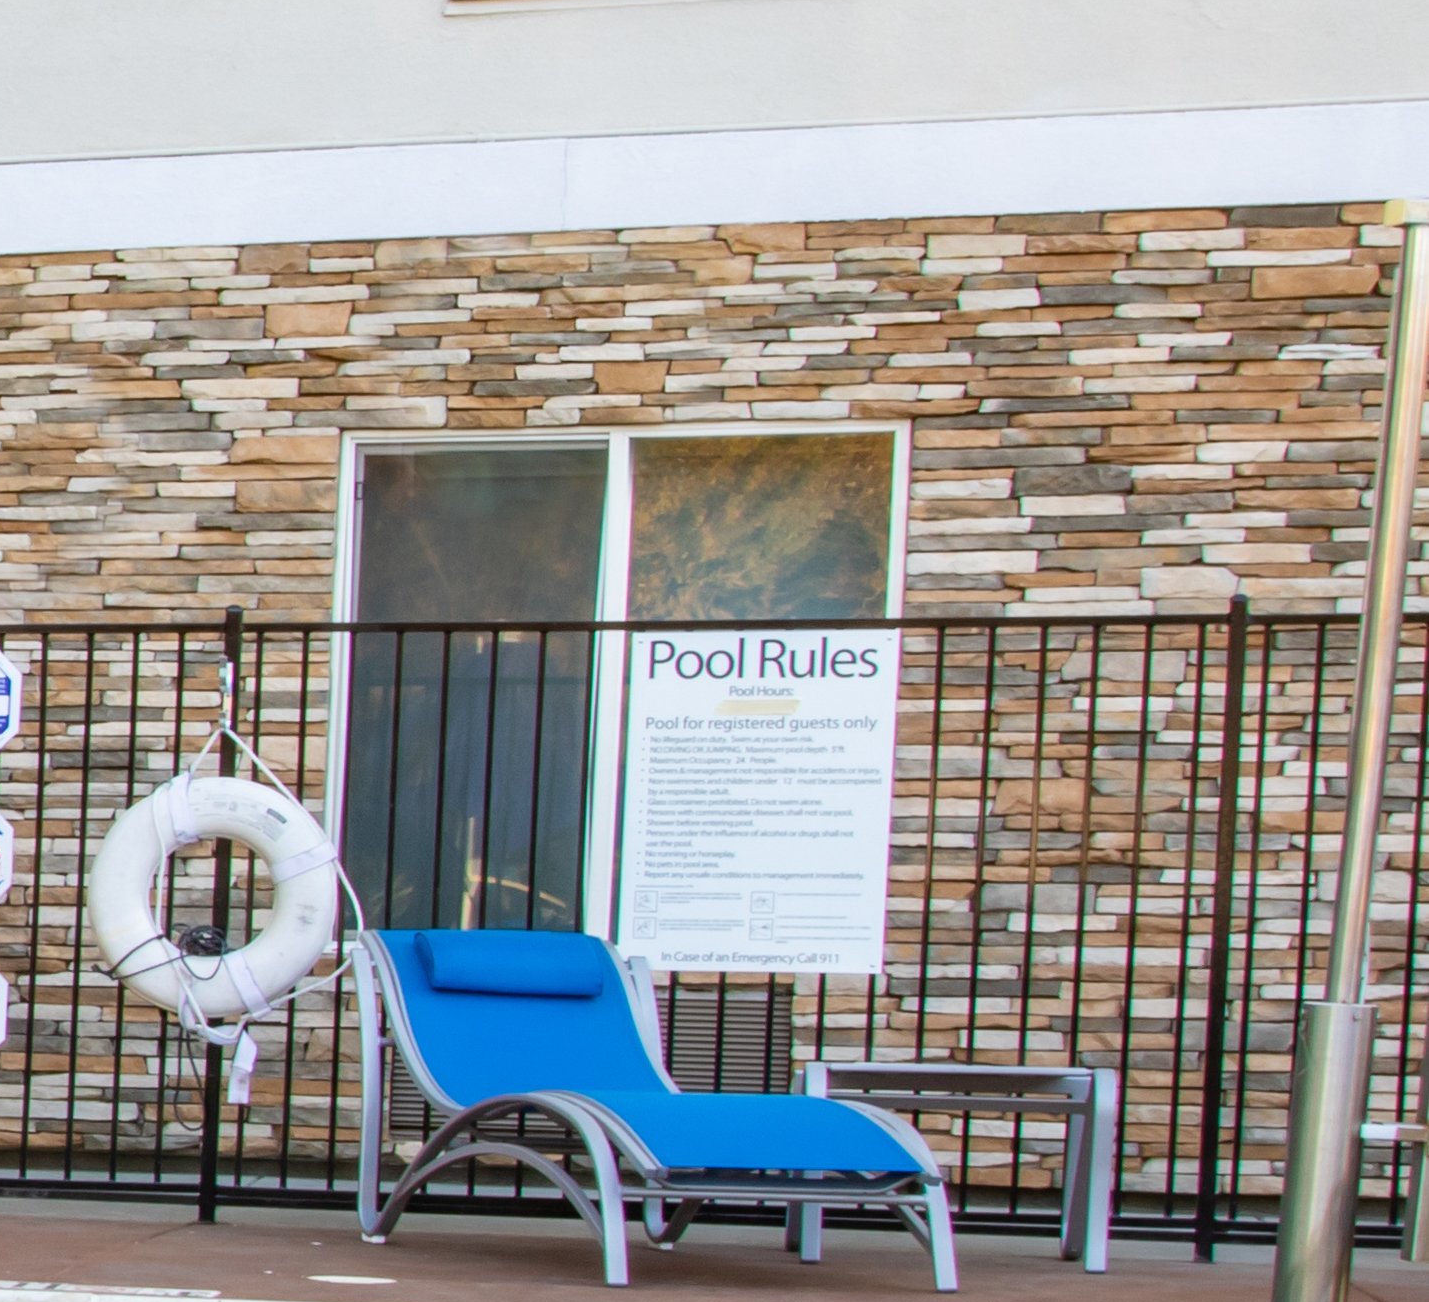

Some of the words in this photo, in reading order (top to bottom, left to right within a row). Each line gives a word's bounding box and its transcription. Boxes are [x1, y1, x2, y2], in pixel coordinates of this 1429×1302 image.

[649, 637, 746, 680] Pool
[759, 636, 879, 679] Rules
[729, 685, 755, 697] Pool
[757, 685, 795, 697] Hours:
[646, 716, 679, 730] Pool
[683, 716, 705, 730] for
[707, 716, 785, 733] registered
[789, 717, 840, 733] guests
[844, 715, 878, 732] only
[661, 951, 672, 962] In
[674, 951, 699, 962] Case
[701, 951, 713, 962] of
[714, 953, 729, 962] an
[732, 951, 795, 966] Emergency
[797, 951, 817, 963] Call
[819, 953, 840, 963] 911
